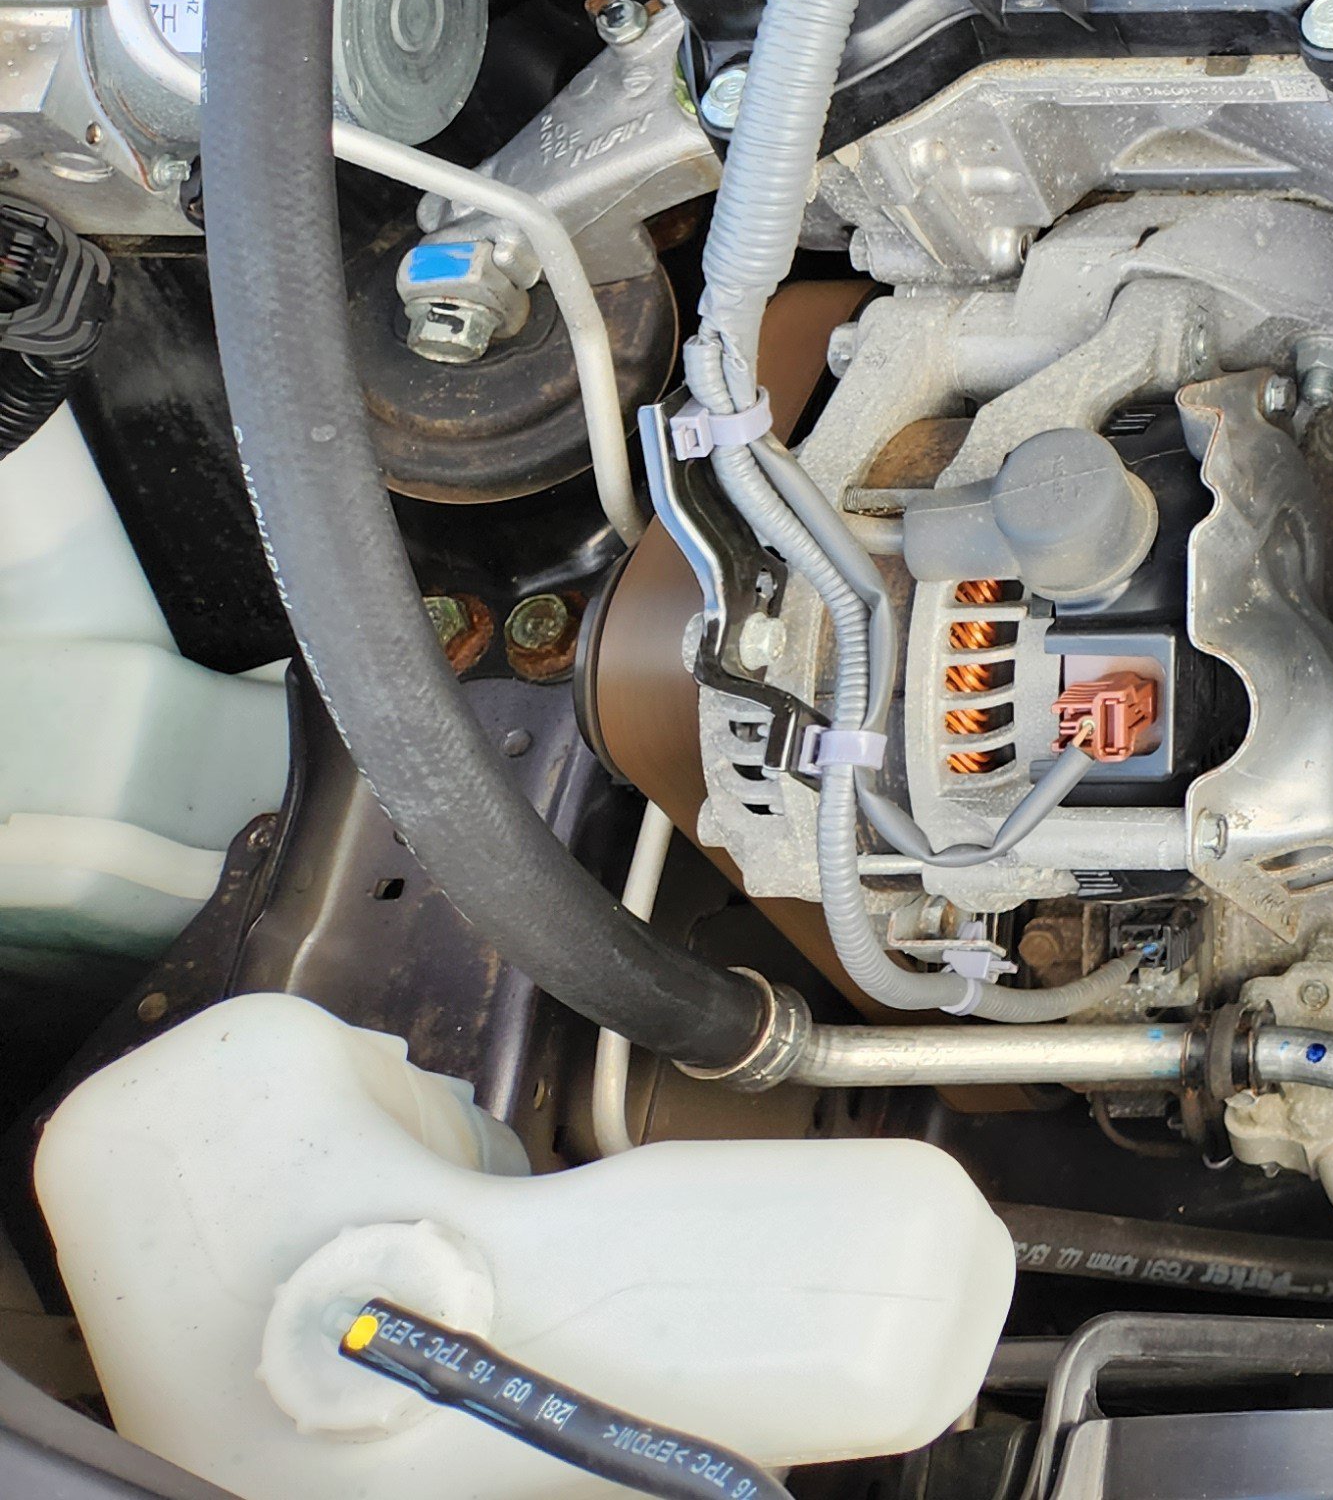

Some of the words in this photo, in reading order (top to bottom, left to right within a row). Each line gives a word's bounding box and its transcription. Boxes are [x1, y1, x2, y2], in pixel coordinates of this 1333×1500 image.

[423, 1336, 470, 1373] TPC
[468, 1358, 497, 1385] 16
[689, 1452, 735, 1488] TPC
